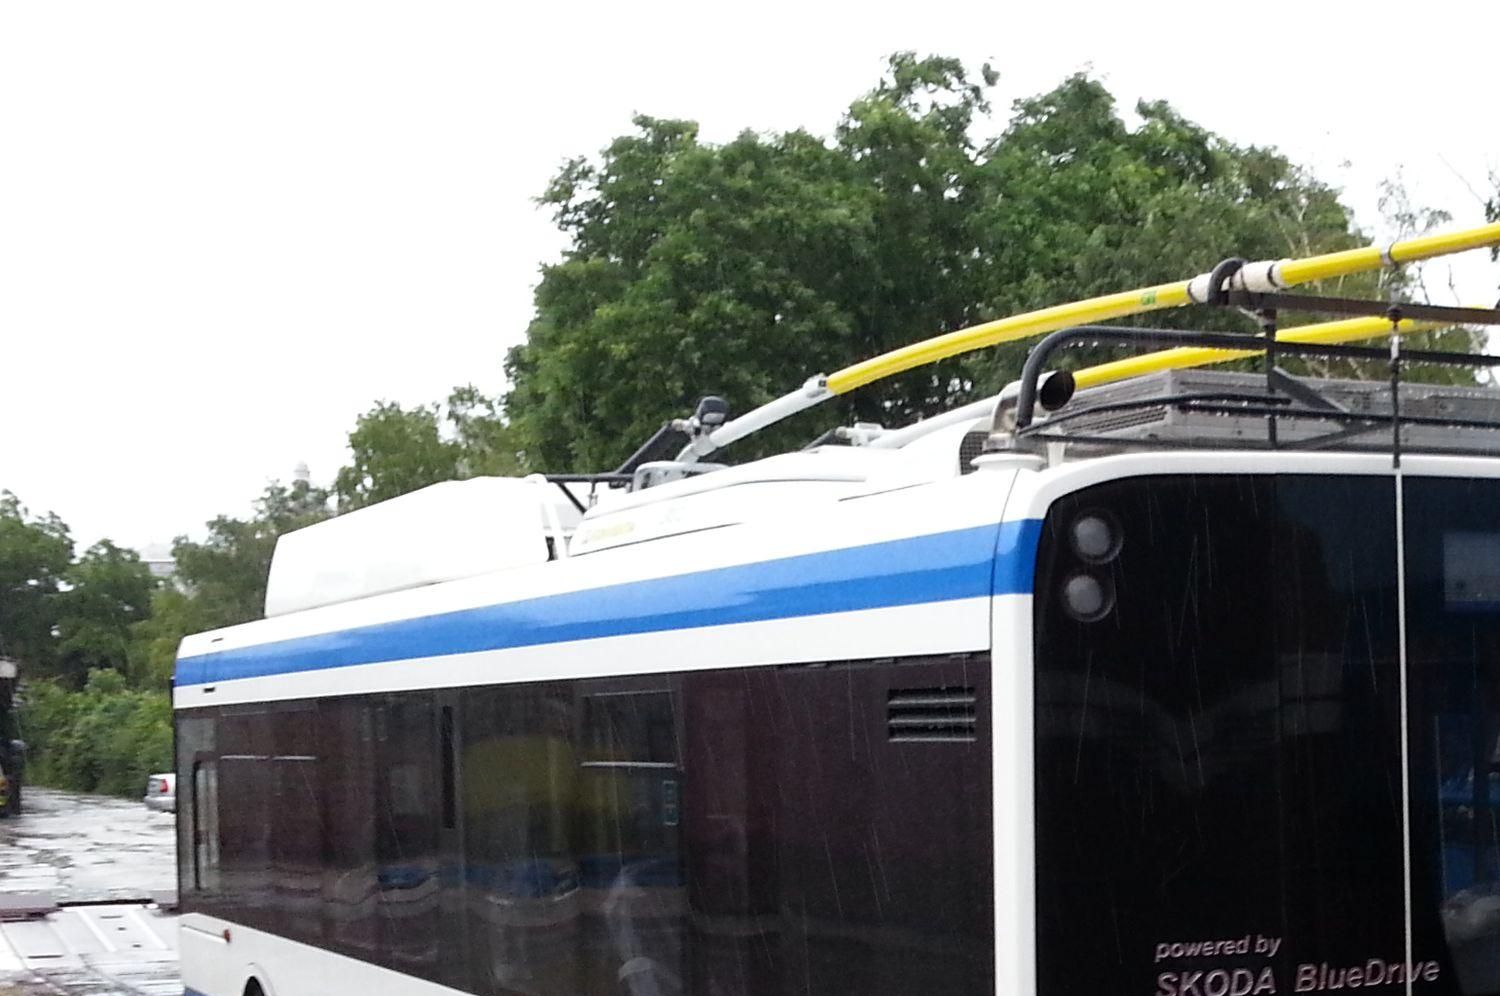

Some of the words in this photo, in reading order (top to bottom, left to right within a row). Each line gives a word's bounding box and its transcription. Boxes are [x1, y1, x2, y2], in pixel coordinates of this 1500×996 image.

[1155, 935, 1250, 962] powered
[1255, 934, 1282, 957] by
[1294, 958, 1440, 992] BlueDrive
